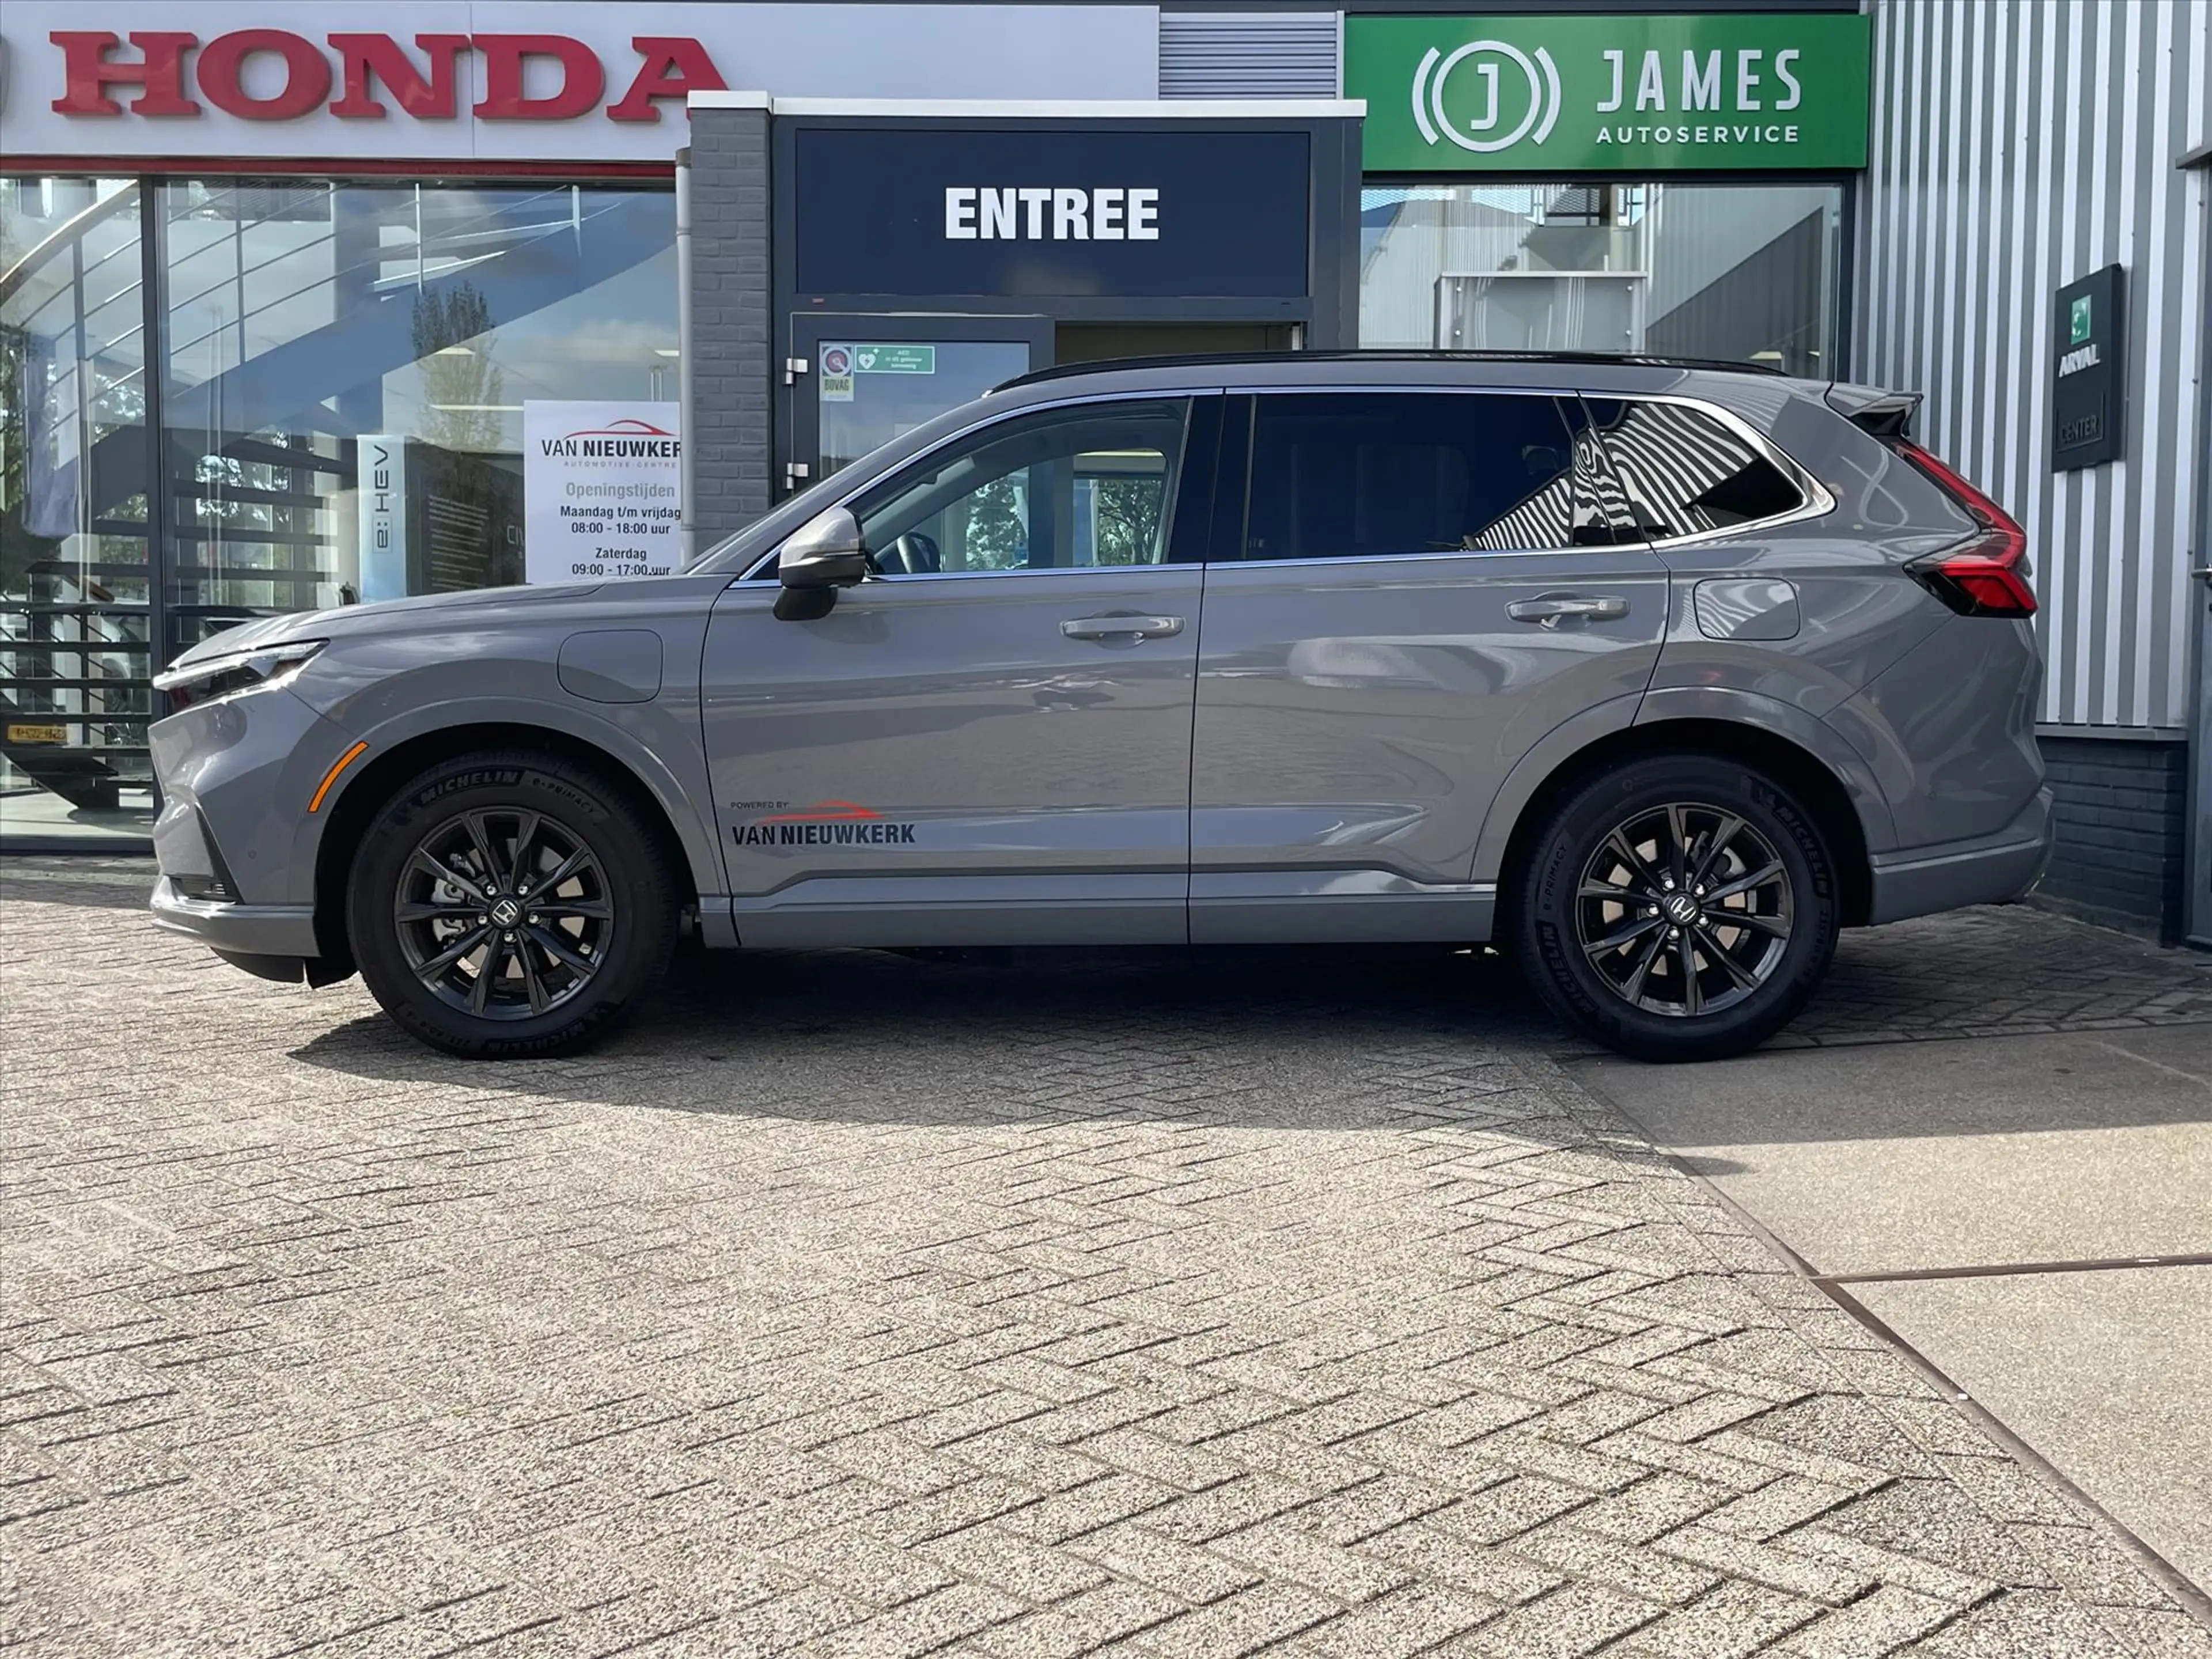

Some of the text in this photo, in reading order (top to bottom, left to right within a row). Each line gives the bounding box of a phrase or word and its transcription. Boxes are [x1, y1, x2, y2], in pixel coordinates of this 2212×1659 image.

[50, 29, 729, 122] HONDA
[1596, 49, 1801, 112] JAMES
[1596, 125, 1798, 144] AUTOSERVICE
[945, 187, 1159, 240] ENTREE
[2058, 344, 2101, 378] ARVAL
[824, 378, 850, 392] BOVAG
[2061, 414, 2099, 444] CENTER
[541, 440, 681, 457] VAN NIEUWKER
[374, 445, 389, 548] e:HEV
[566, 482, 675, 499] Openingstijden
[560, 506, 681, 520] Maandag t/m vrijdag
[571, 522, 603, 533] 08:00
[616, 523, 647, 534] 18:00
[651, 525, 671, 534] uur
[596, 548, 647, 561] Zaterdag
[572, 564, 604, 575] 09:00
[616, 565, 647, 575] 17:00
[650, 566, 671, 575] uur
[421, 771, 520, 804] MICHELIN
[732, 824, 915, 845] VAN NIEUWKERK
[1776, 807, 1829, 895] MICHELIN
